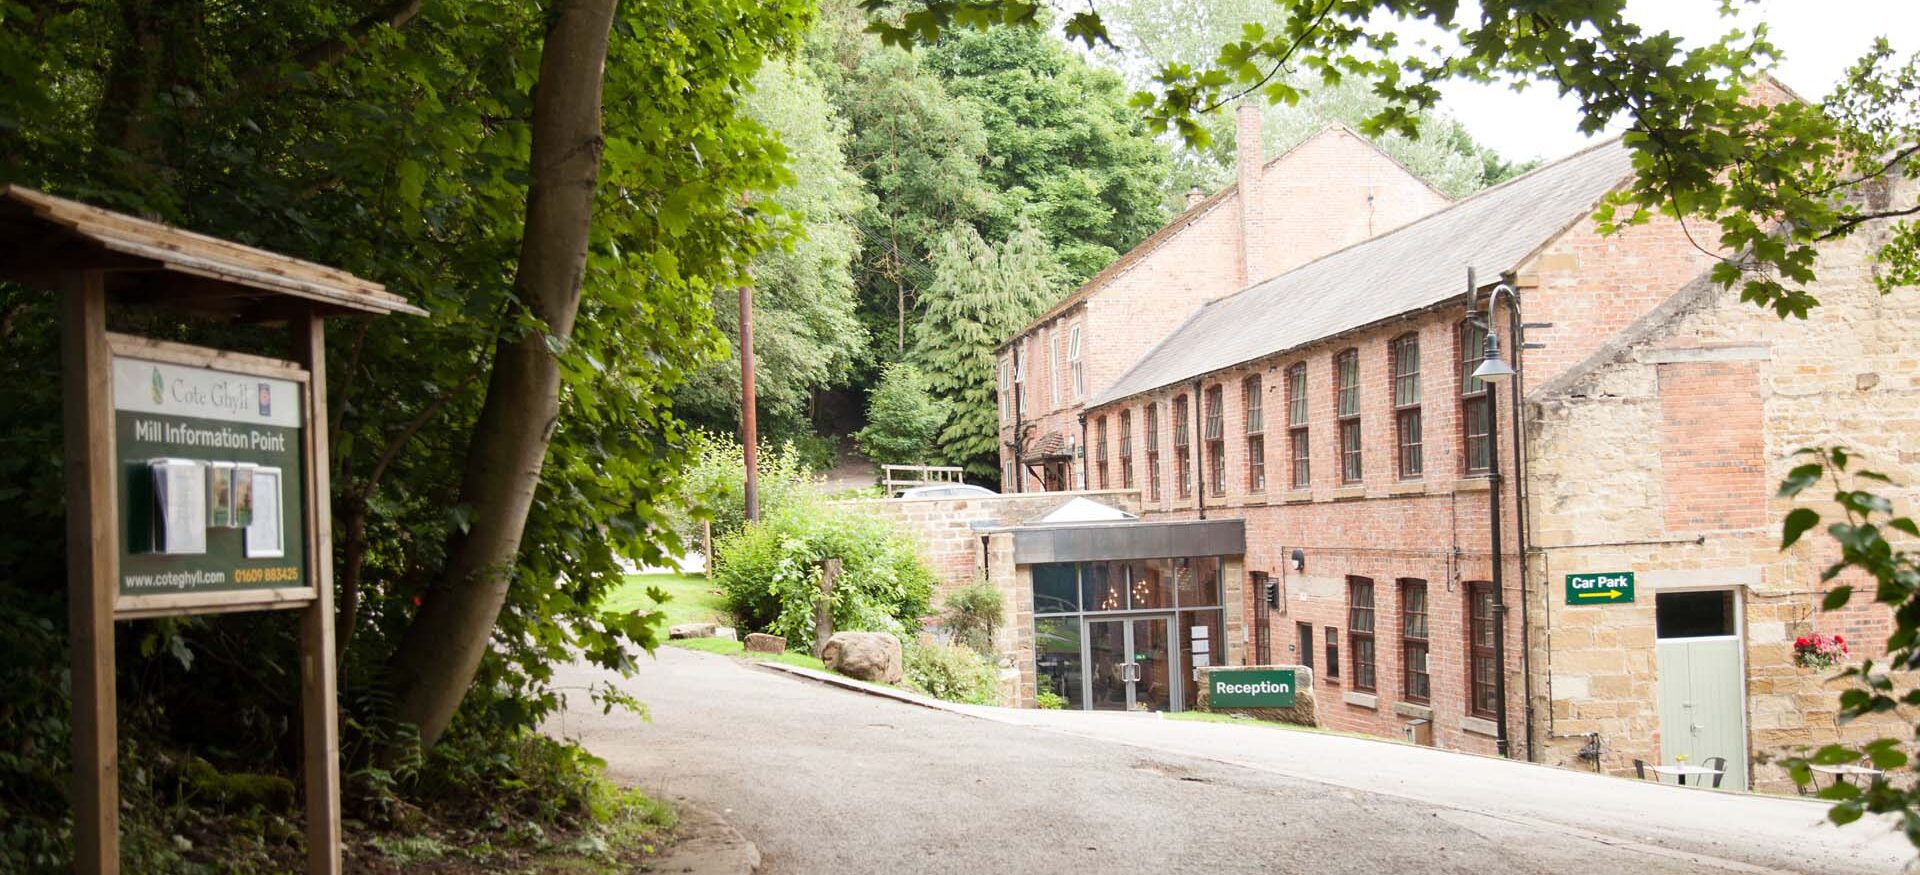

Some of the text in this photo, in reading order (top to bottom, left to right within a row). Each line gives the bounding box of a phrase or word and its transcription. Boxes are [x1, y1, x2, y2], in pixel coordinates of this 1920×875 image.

[171, 379, 248, 414] Cote Ghyll
[135, 421, 285, 452] Mill Information Point
[126, 570, 225, 588] www.coteghyll.com
[235, 568, 298, 583] 01609 883425
[1572, 576, 1628, 589] Car Park
[1217, 681, 1289, 695] Reception
